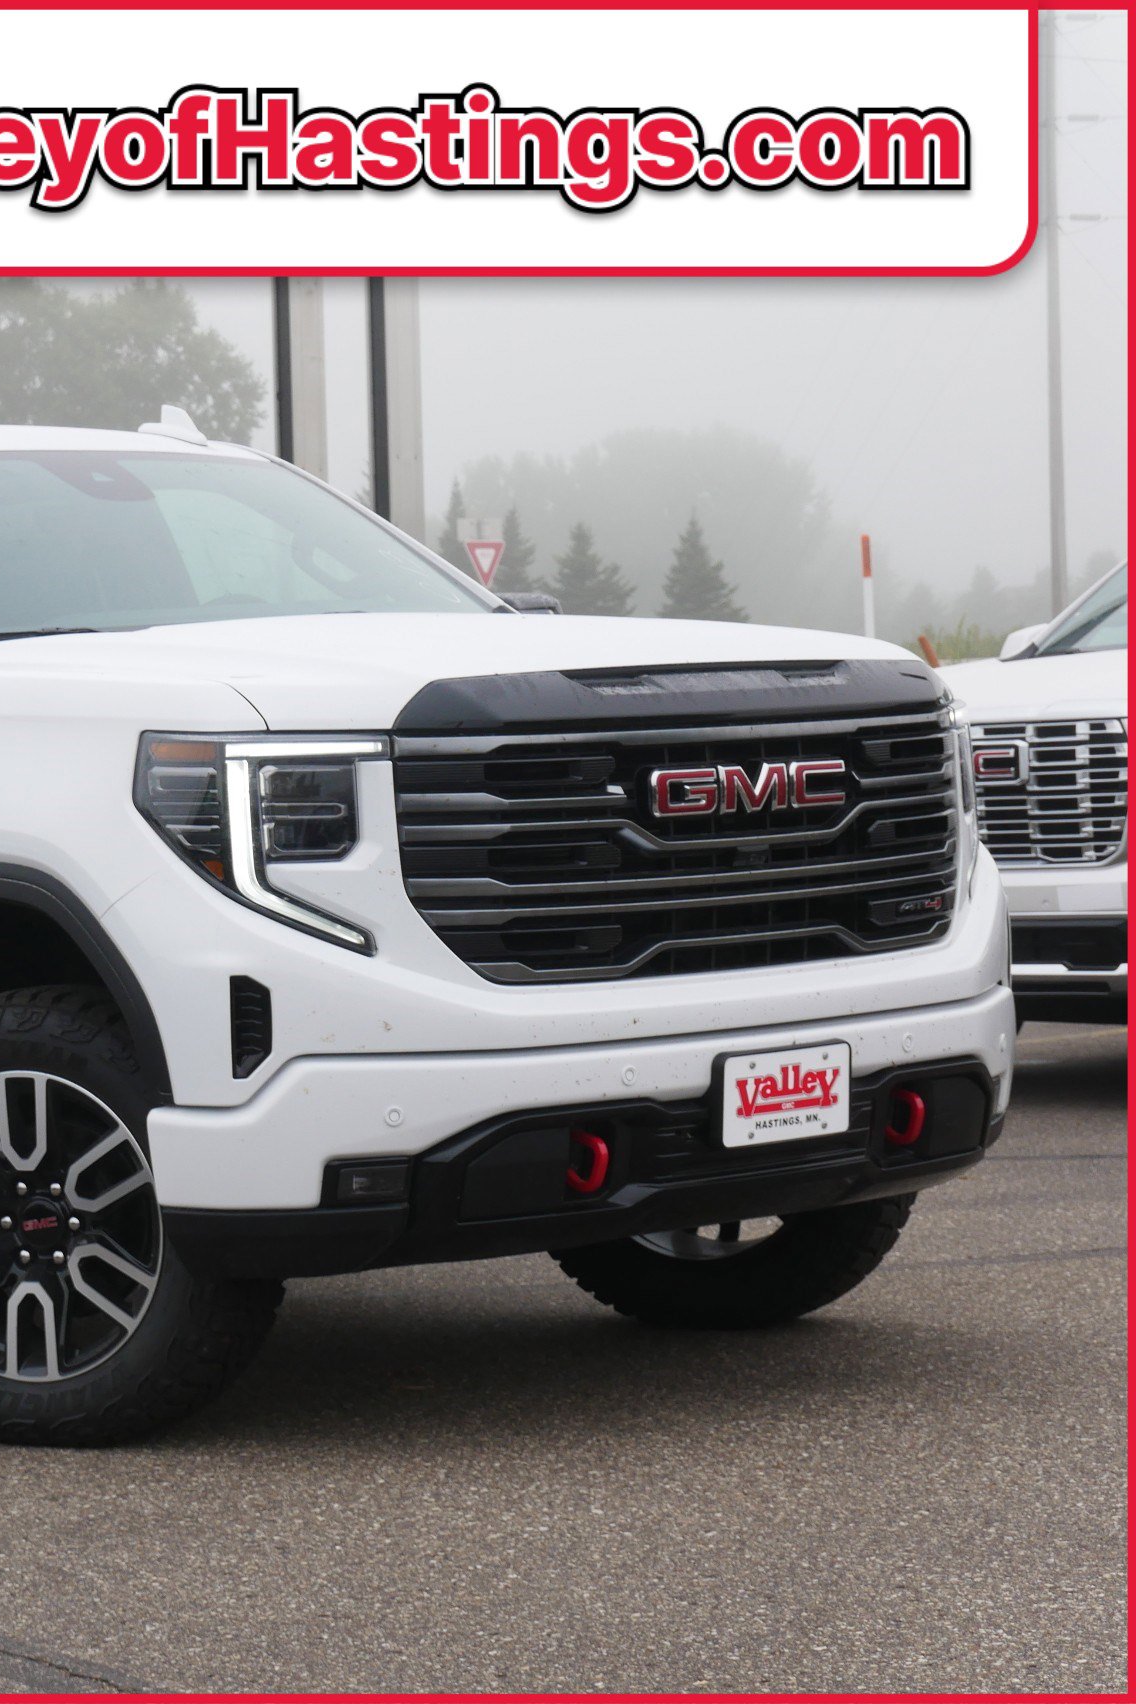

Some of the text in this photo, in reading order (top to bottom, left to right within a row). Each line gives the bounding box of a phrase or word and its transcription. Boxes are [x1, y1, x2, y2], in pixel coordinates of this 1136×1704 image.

[650, 759, 846, 817] GMC
[736, 1064, 840, 1117] Valley
[755, 1116, 803, 1130] HASTINGS,
[22, 1216, 58, 1232] GMC
